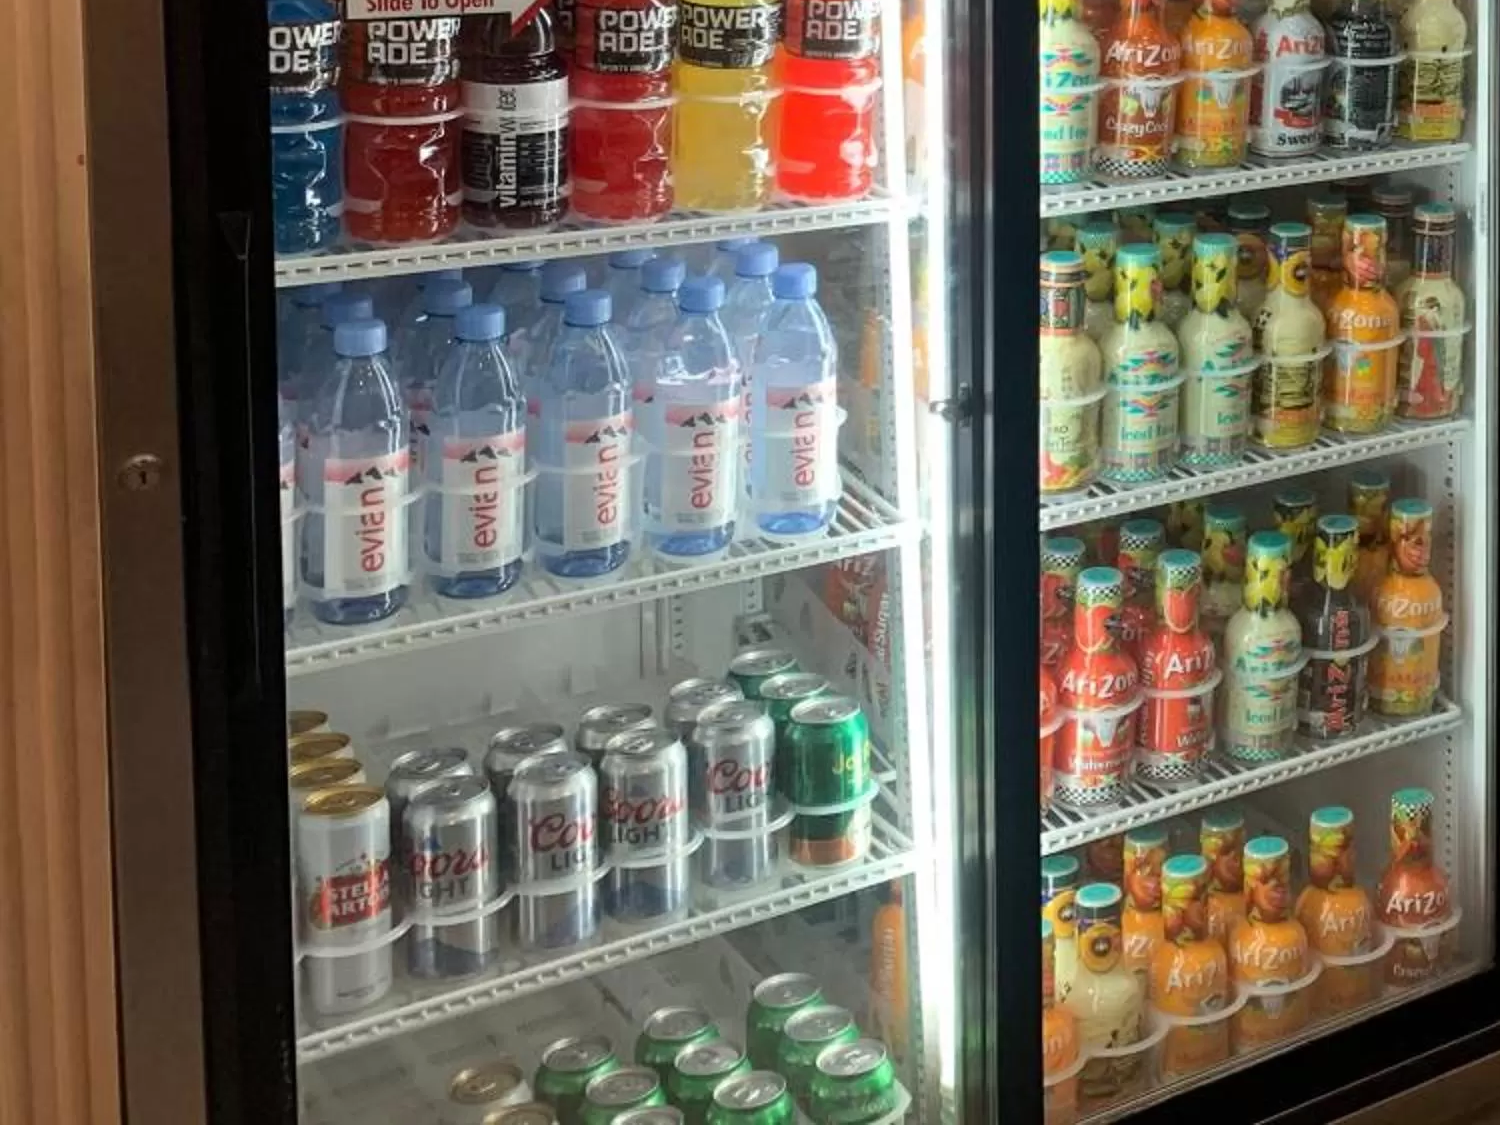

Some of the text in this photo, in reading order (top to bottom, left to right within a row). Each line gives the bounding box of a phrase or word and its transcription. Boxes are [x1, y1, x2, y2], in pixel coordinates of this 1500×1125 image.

[269, 19, 341, 49] OWER
[367, 41, 427, 65] ADE
[599, 31, 655, 52] ADE
[806, 20, 859, 40] ADE
[268, 51, 310, 74] DE
[496, 87, 518, 208] vitaminwter
[689, 430, 715, 509] evian
[791, 410, 815, 488] evian
[468, 463, 498, 548] evian
[593, 444, 618, 525] evian
[355, 483, 385, 572] evian
[328, 869, 390, 902] STELA
